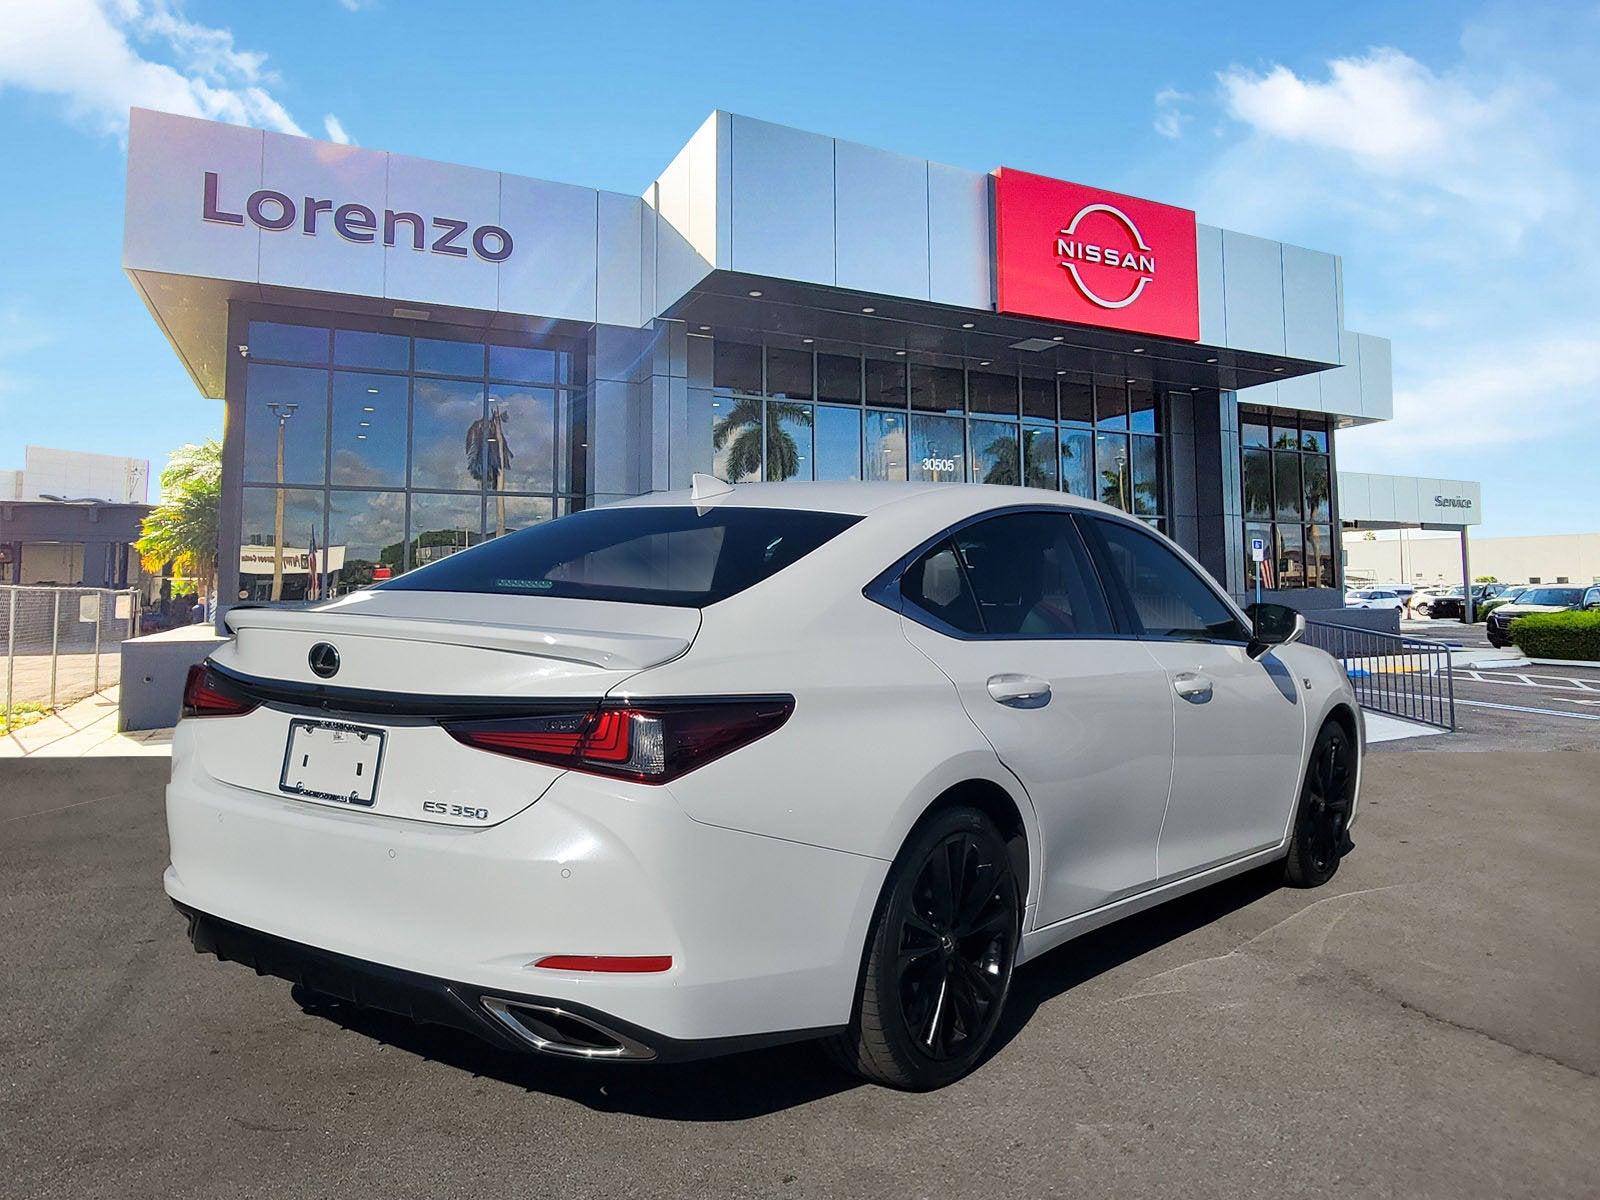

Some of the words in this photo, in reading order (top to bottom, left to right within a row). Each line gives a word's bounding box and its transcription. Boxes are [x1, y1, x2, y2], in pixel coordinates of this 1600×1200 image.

[202, 171, 515, 262] Lorenzo
[1057, 238, 1155, 273] NISSAN
[922, 457, 955, 472] 30505
[1434, 495, 1473, 509] Service
[422, 800, 448, 815] ES
[449, 804, 489, 820] 350
